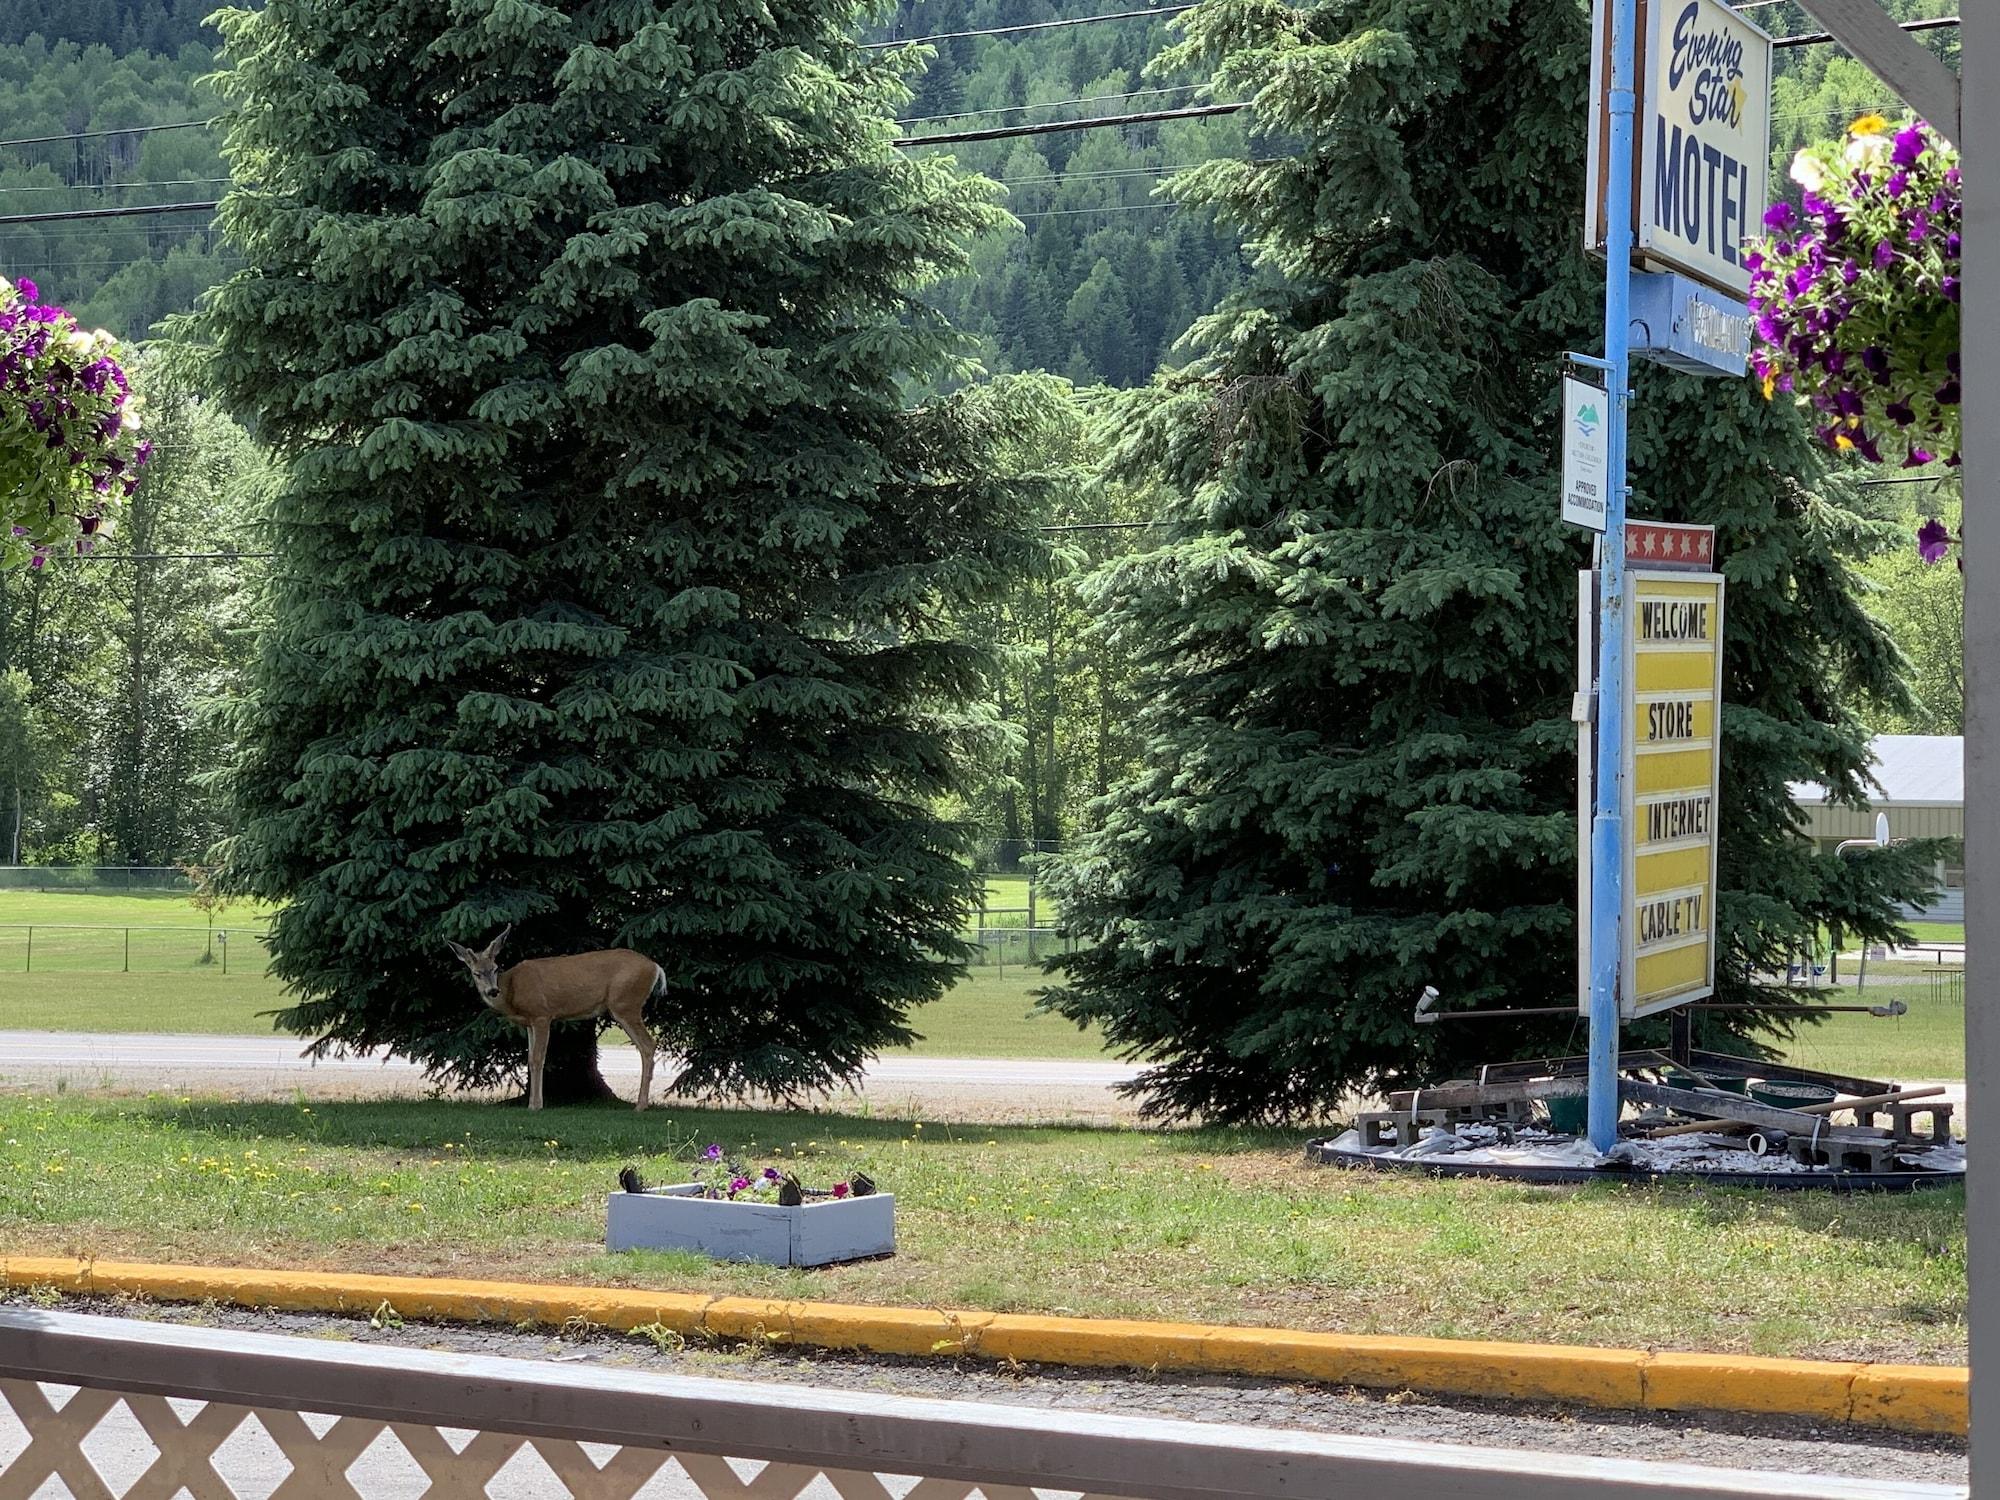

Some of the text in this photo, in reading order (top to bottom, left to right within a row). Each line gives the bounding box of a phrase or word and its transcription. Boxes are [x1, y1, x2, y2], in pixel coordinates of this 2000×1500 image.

[1669, 1, 1743, 91] Evening
[1688, 68, 1741, 129] Star
[1654, 113, 1754, 274] MOTEL
[1642, 602, 1707, 640] WELCOME
[1649, 702, 1693, 740] STORE
[1648, 797, 1710, 841] INTERNET
[1640, 894, 1702, 942] CABLE TV
